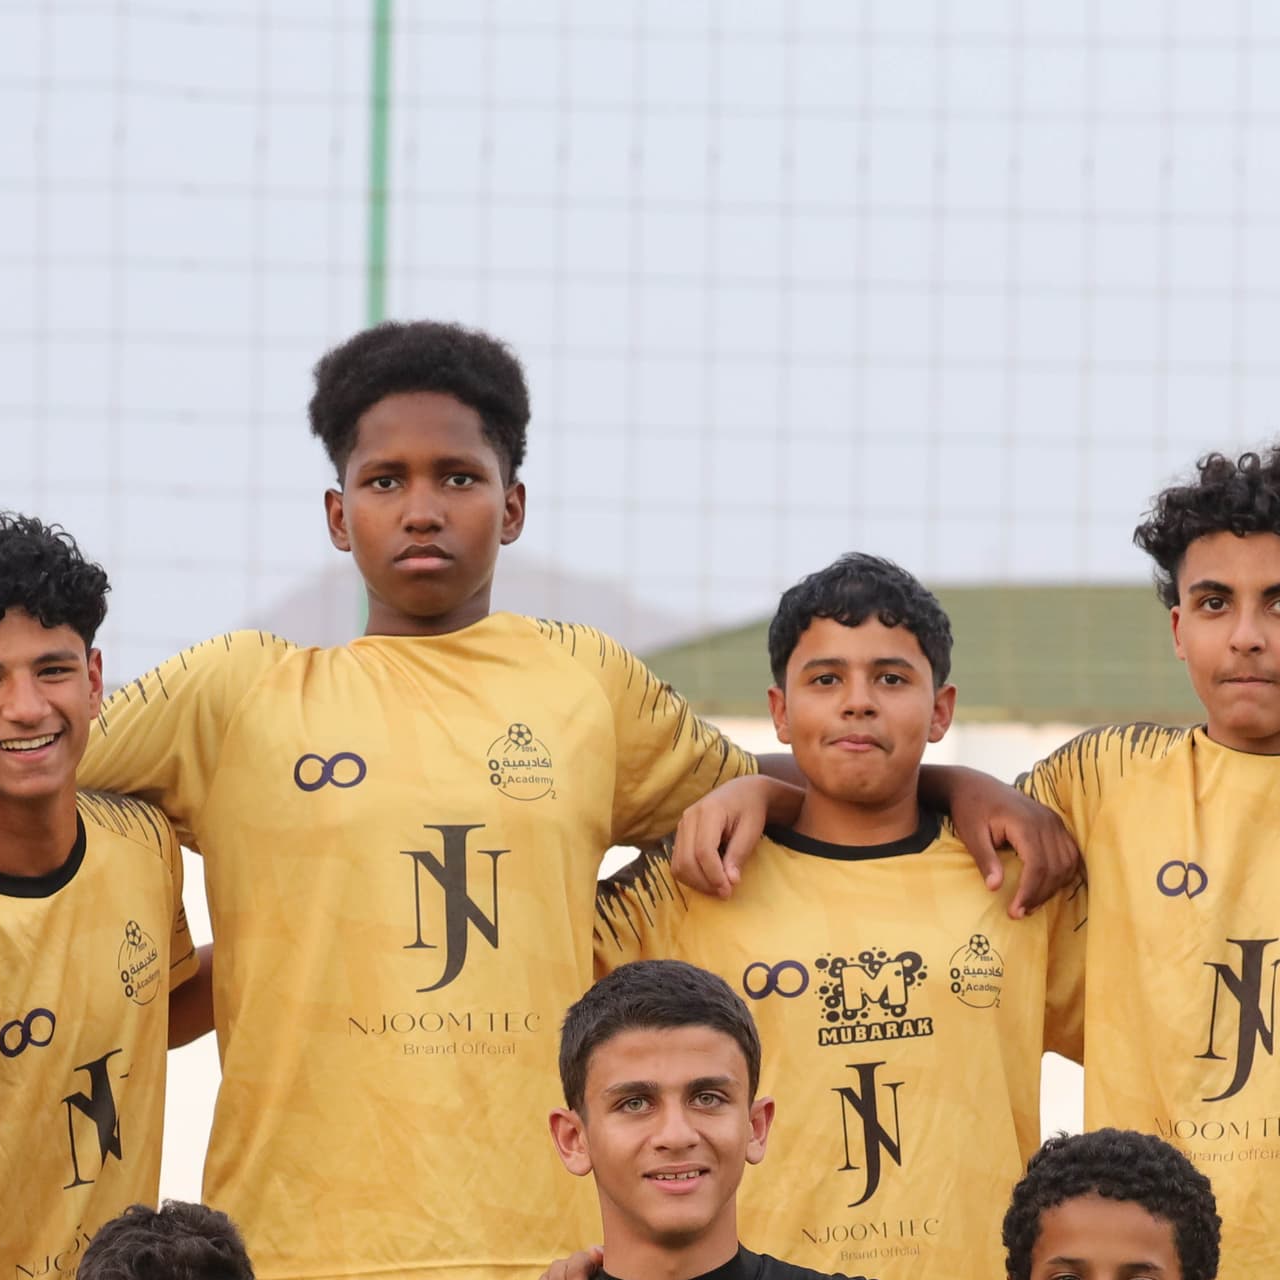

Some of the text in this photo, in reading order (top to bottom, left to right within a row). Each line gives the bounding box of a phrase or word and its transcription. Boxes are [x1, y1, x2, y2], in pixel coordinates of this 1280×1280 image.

[348, 1012, 472, 1036] NJOOM
[818, 1017, 934, 1046] MUBARAK
[403, 1042, 457, 1056] Brand
